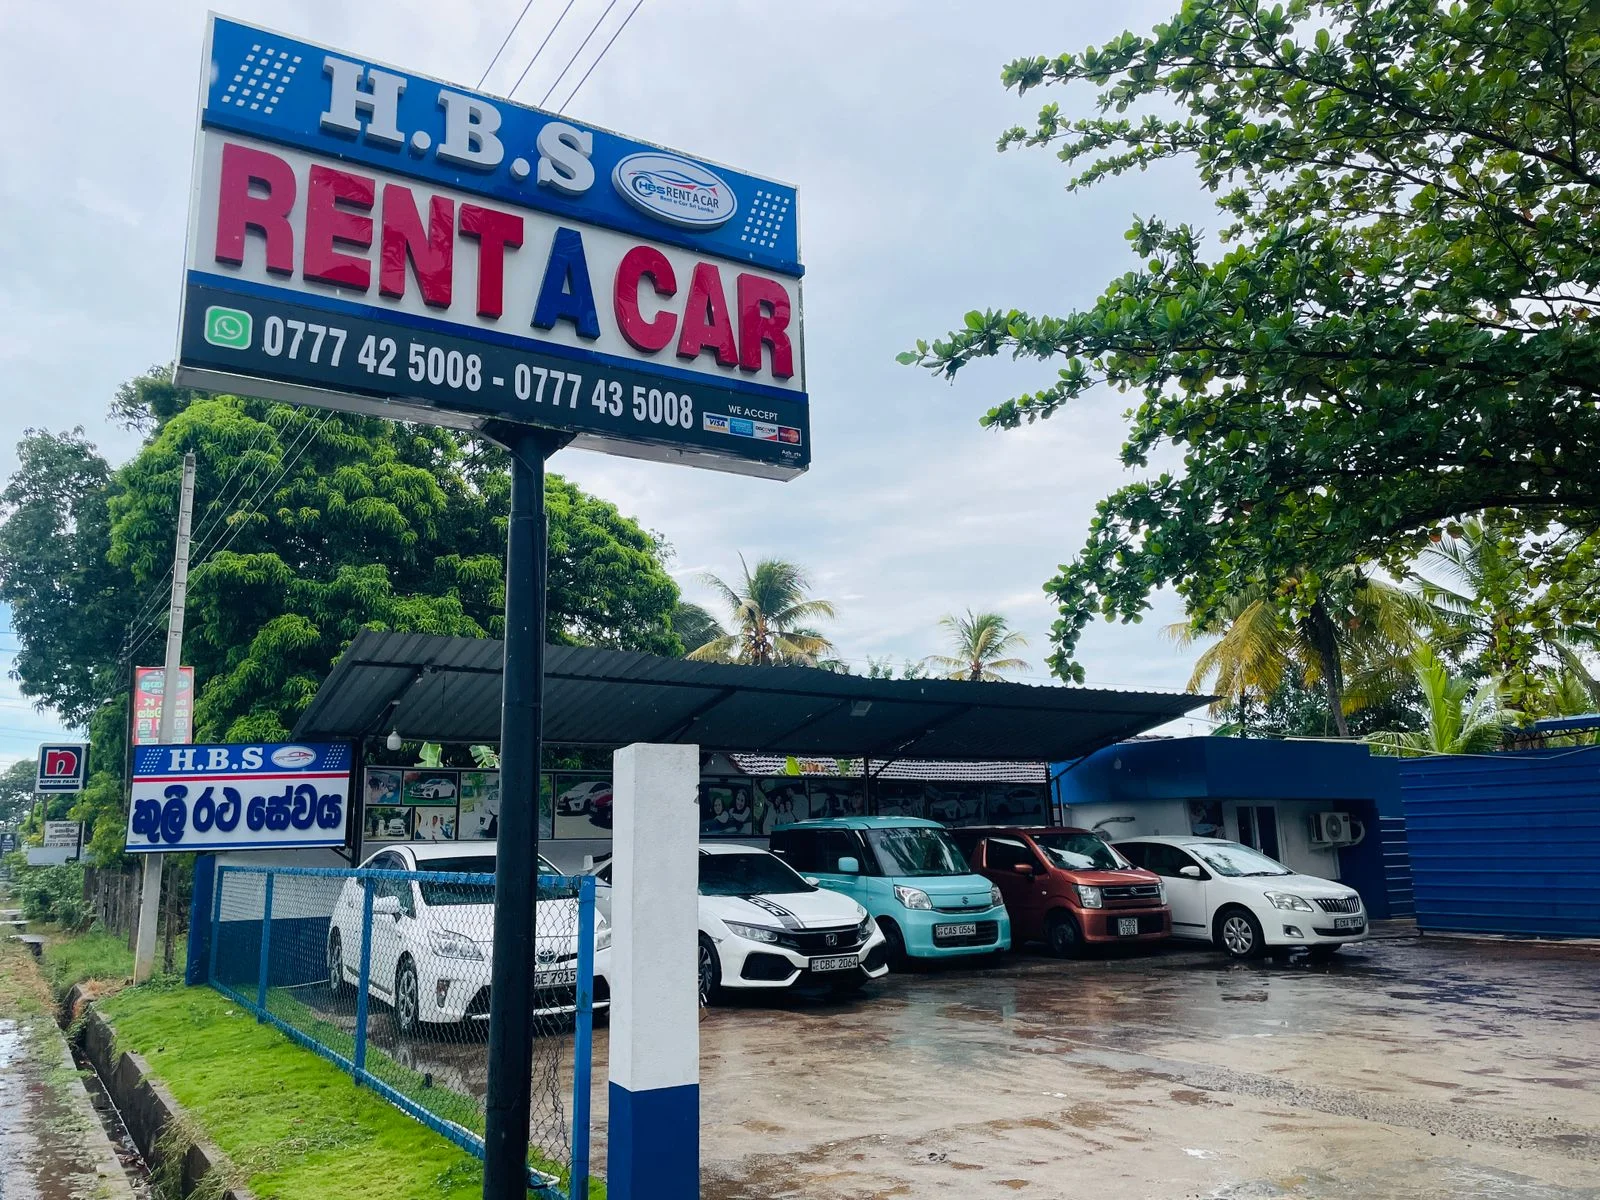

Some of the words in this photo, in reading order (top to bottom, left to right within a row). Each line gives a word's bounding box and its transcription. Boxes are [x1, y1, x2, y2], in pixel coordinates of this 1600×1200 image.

[320, 56, 595, 196] H.B.S
[666, 186, 691, 202] RENT
[692, 194, 699, 204] A
[700, 195, 719, 209] CAR
[215, 142, 524, 319] RENT
[530, 226, 600, 340] A
[613, 246, 794, 380] CAR
[263, 316, 348, 367] 0777
[358, 335, 397, 377] 42
[408, 343, 482, 392] 5008
[514, 363, 582, 409] 0777
[591, 379, 624, 417] 43
[632, 385, 694, 429] 5008
[709, 418, 726, 428] VISA
[728, 404, 741, 415] WE
[743, 408, 778, 421] ACCEPT
[167, 747, 264, 771] H.B.S
[820, 957, 836, 969] CBC
[838, 957, 858, 969] 2064
[550, 970, 576, 984] 7915
